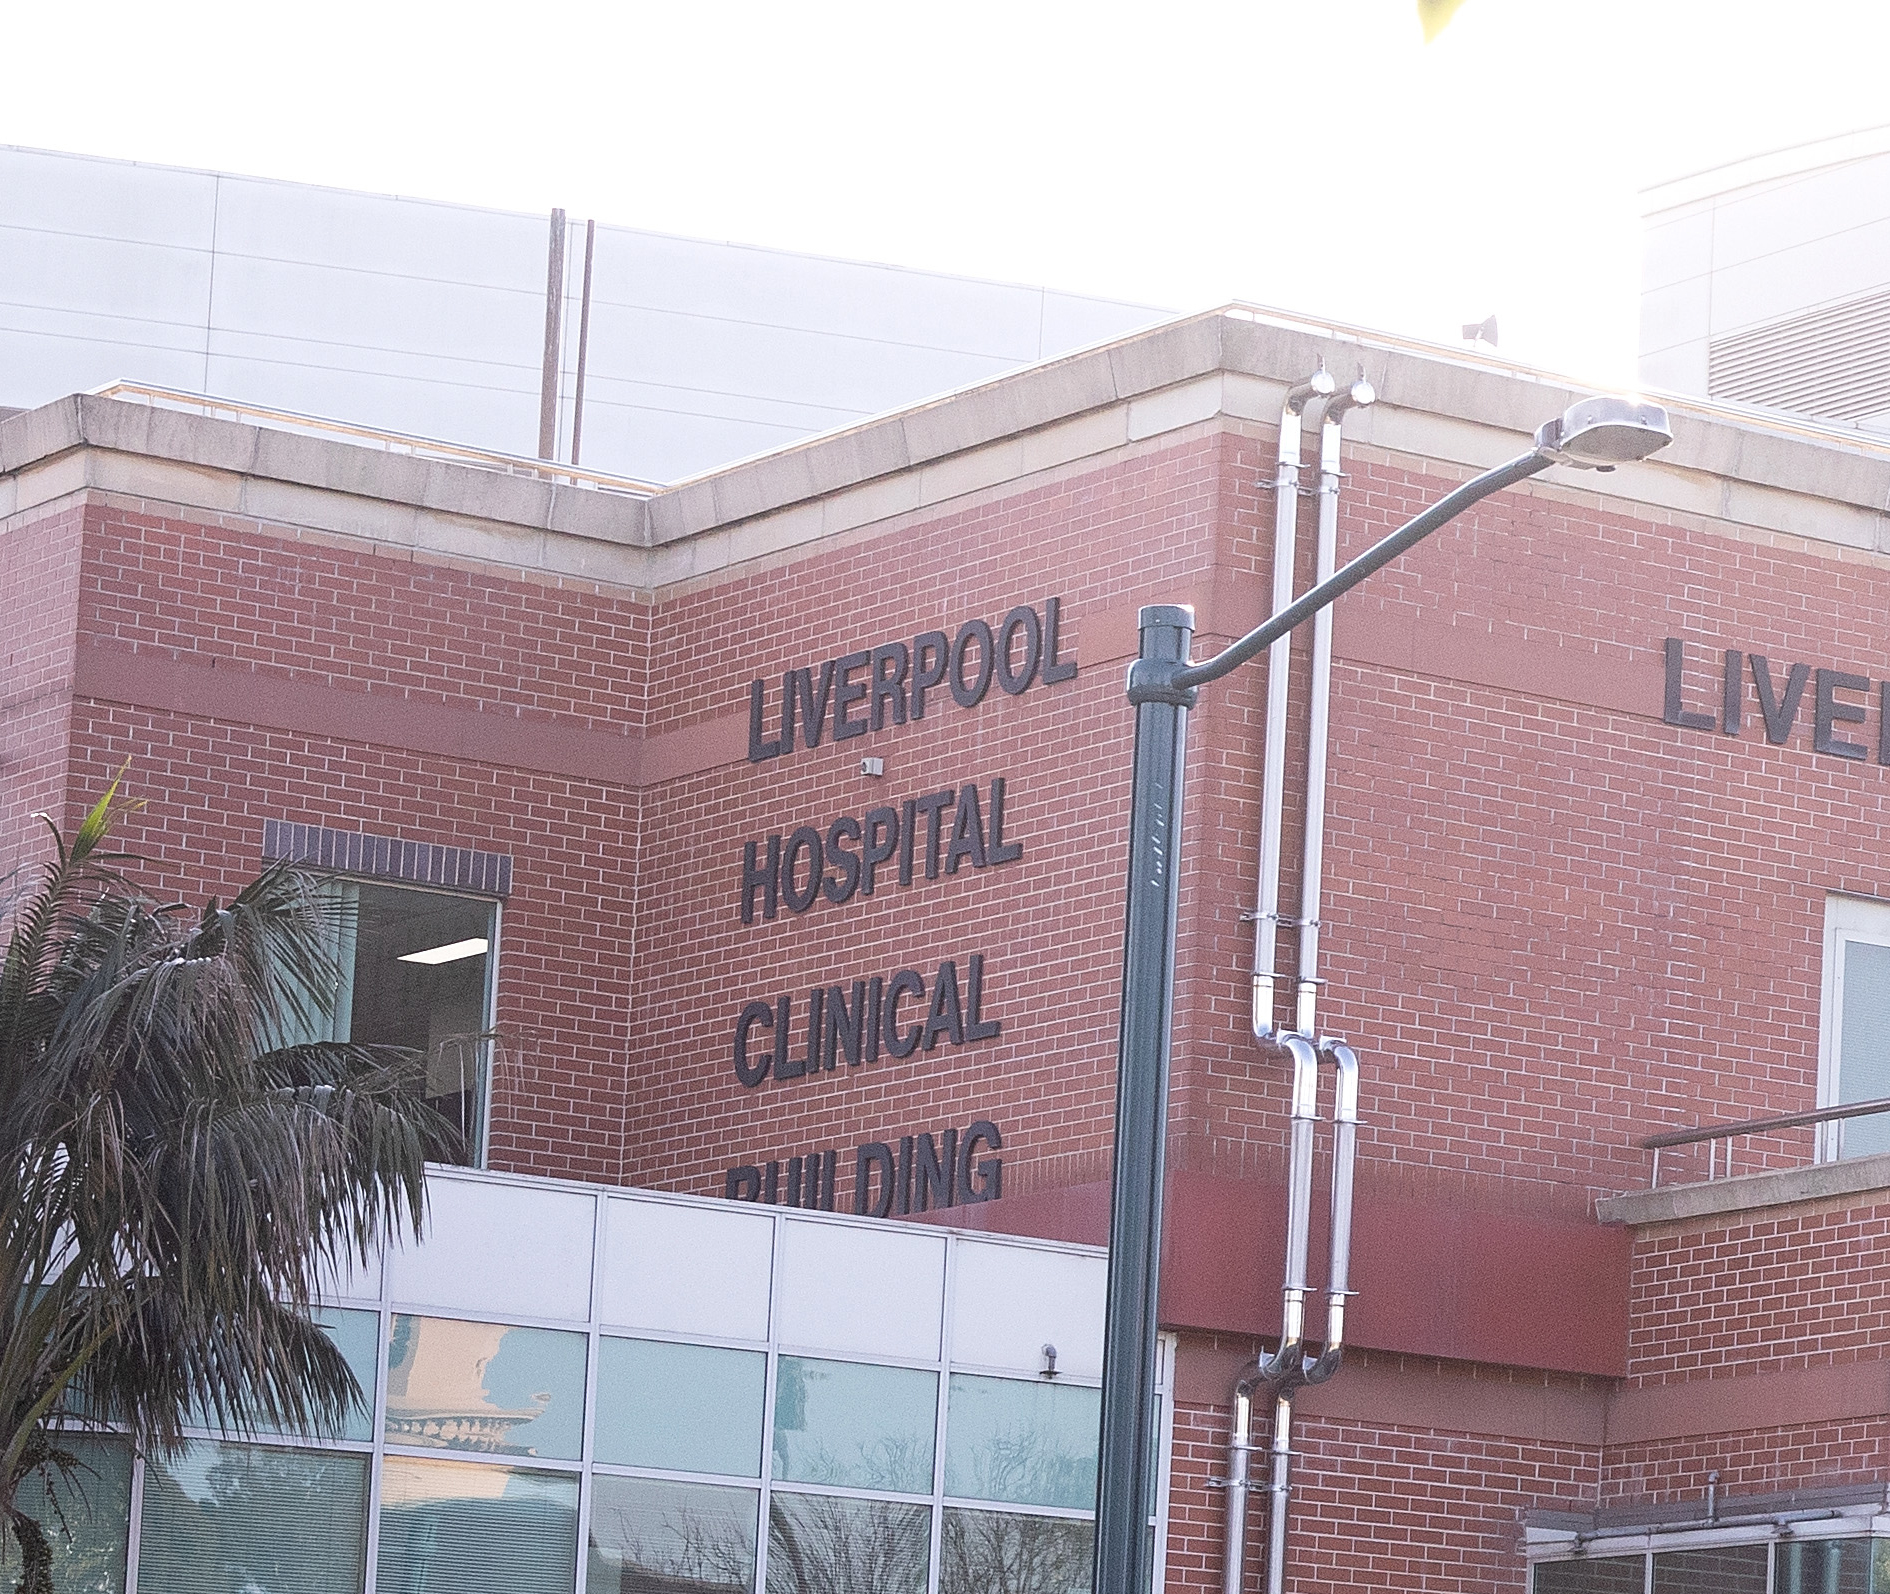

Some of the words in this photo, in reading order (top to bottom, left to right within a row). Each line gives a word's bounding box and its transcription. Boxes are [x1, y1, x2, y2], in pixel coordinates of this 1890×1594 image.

[747, 597, 1078, 762] LIVERPOOL
[741, 777, 1024, 924] HOSPITAL
[733, 953, 1000, 1088] CLINICAL
